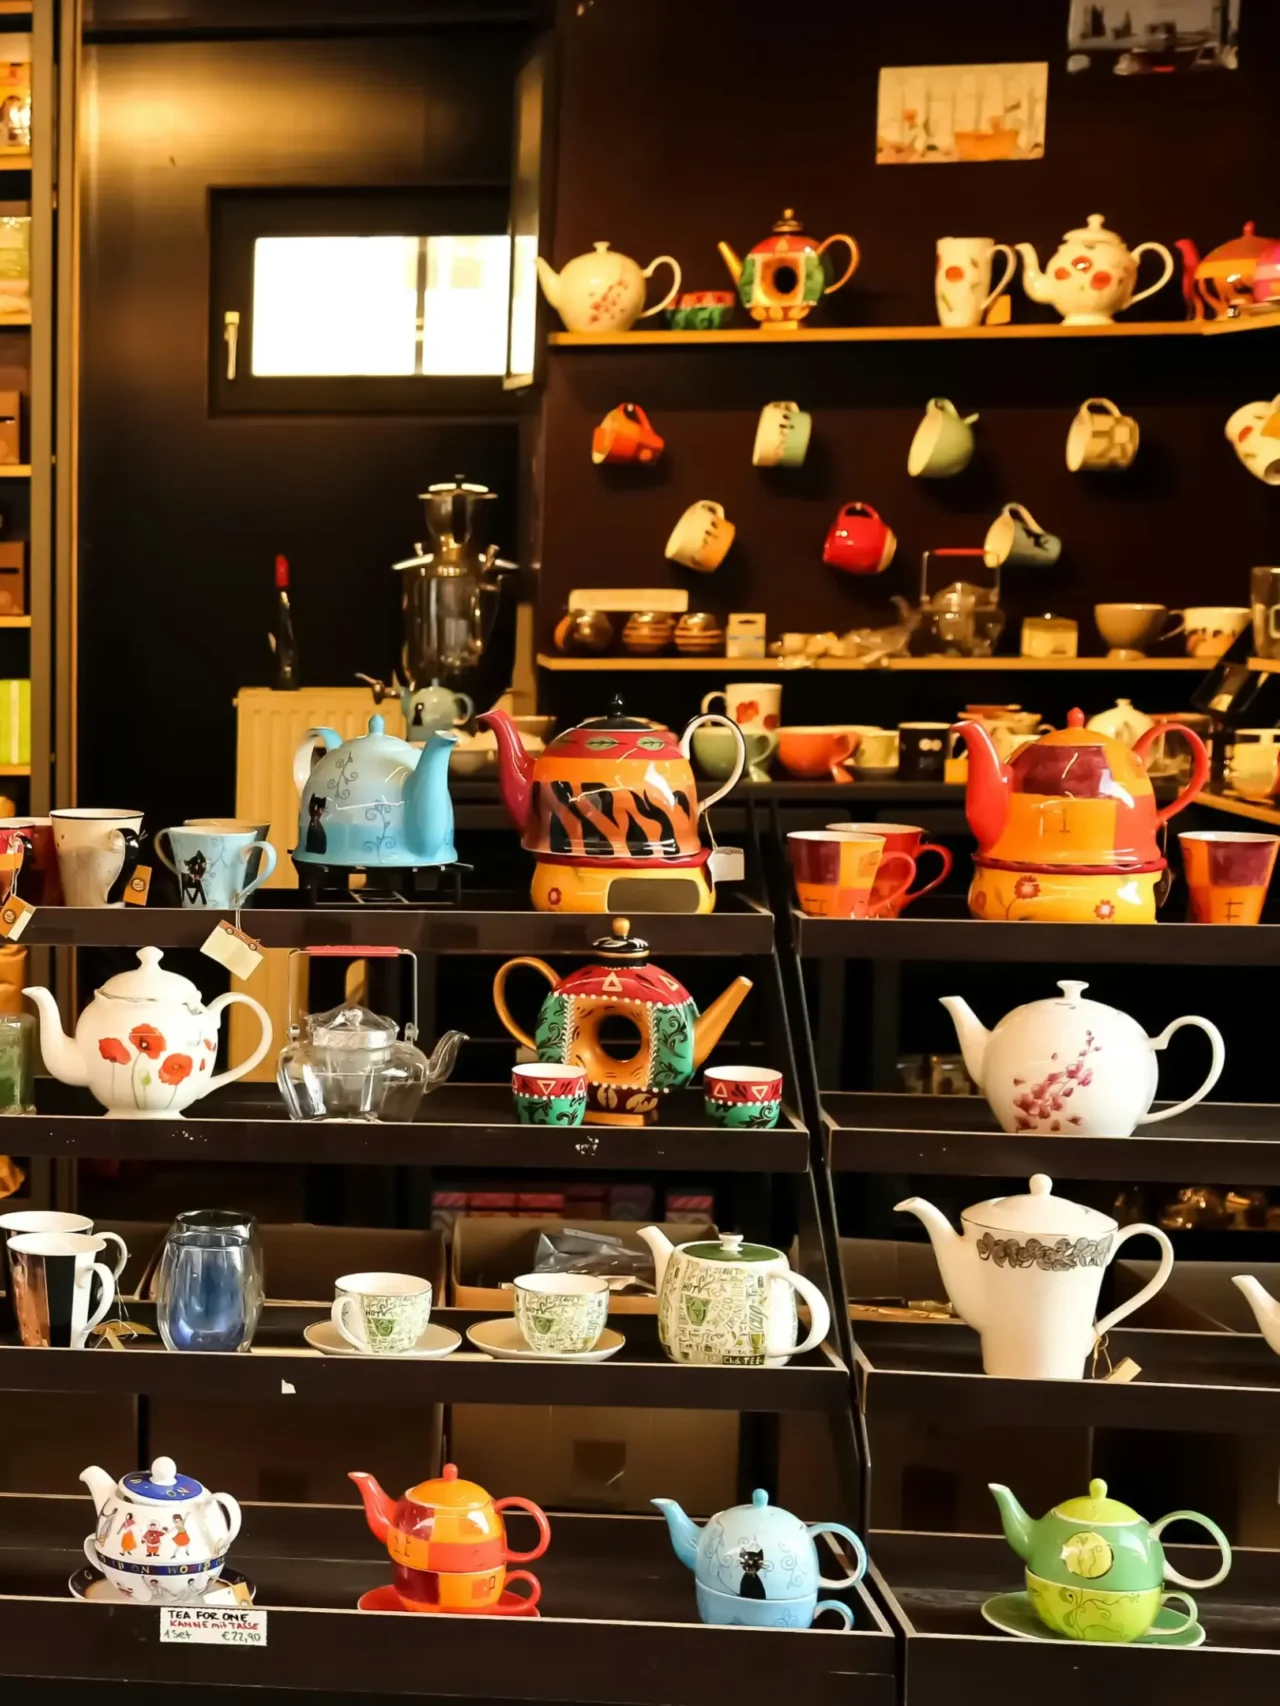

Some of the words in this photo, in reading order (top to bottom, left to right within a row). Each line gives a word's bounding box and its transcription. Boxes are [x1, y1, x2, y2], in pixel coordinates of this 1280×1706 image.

[167, 1610, 191, 1619] TEA
[197, 1611, 220, 1620] FOR
[222, 1612, 249, 1622] ONE
[170, 1620, 209, 1628] KANNE
[229, 1622, 259, 1630] TASSE
[221, 1631, 261, 1643] €22,90
